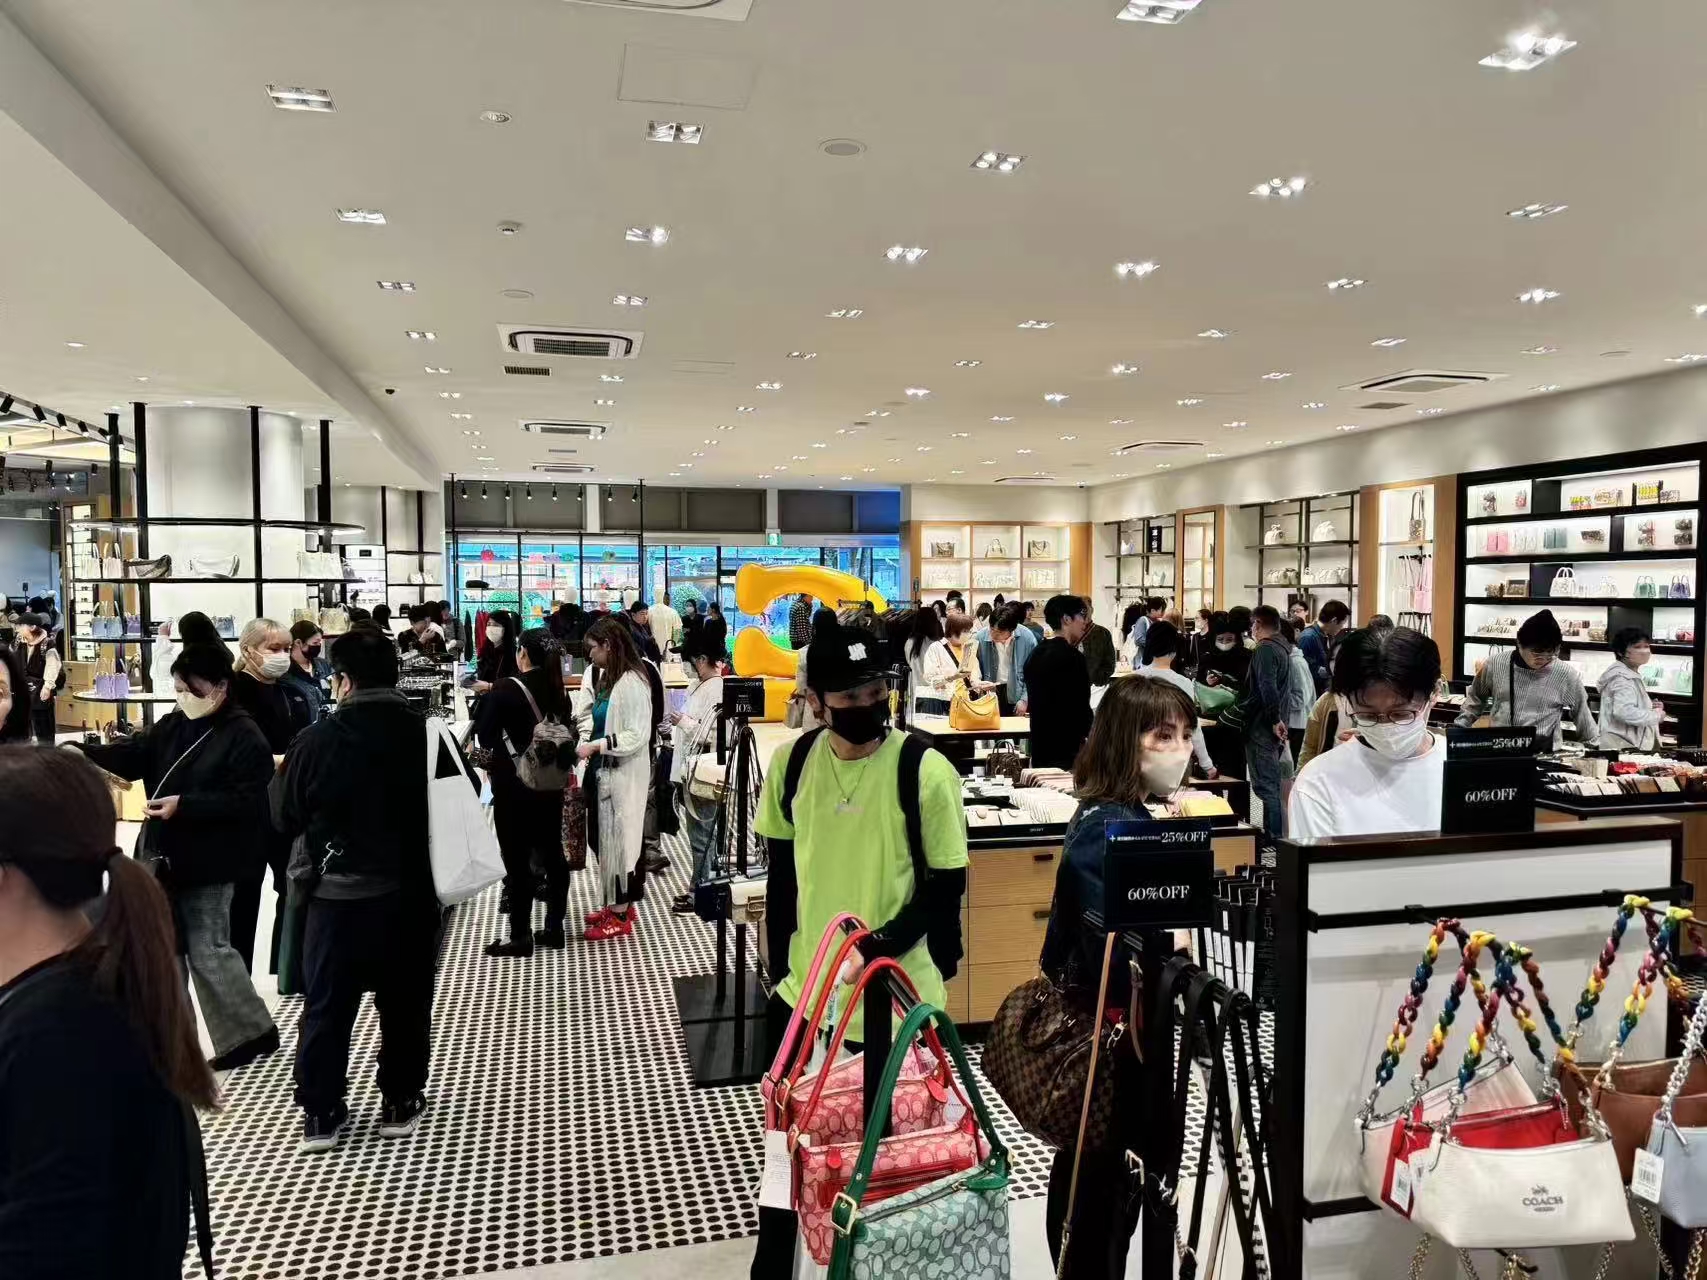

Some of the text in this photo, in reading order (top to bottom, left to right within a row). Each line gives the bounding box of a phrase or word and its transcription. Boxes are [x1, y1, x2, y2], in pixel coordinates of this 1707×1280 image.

[1492, 737, 1533, 749] 25%OFF
[1464, 787, 1518, 803] 60%OFF
[1161, 831, 1209, 843] 25%OFF
[1127, 884, 1190, 901] 60%OFF
[1522, 1196, 1564, 1206] COACH
